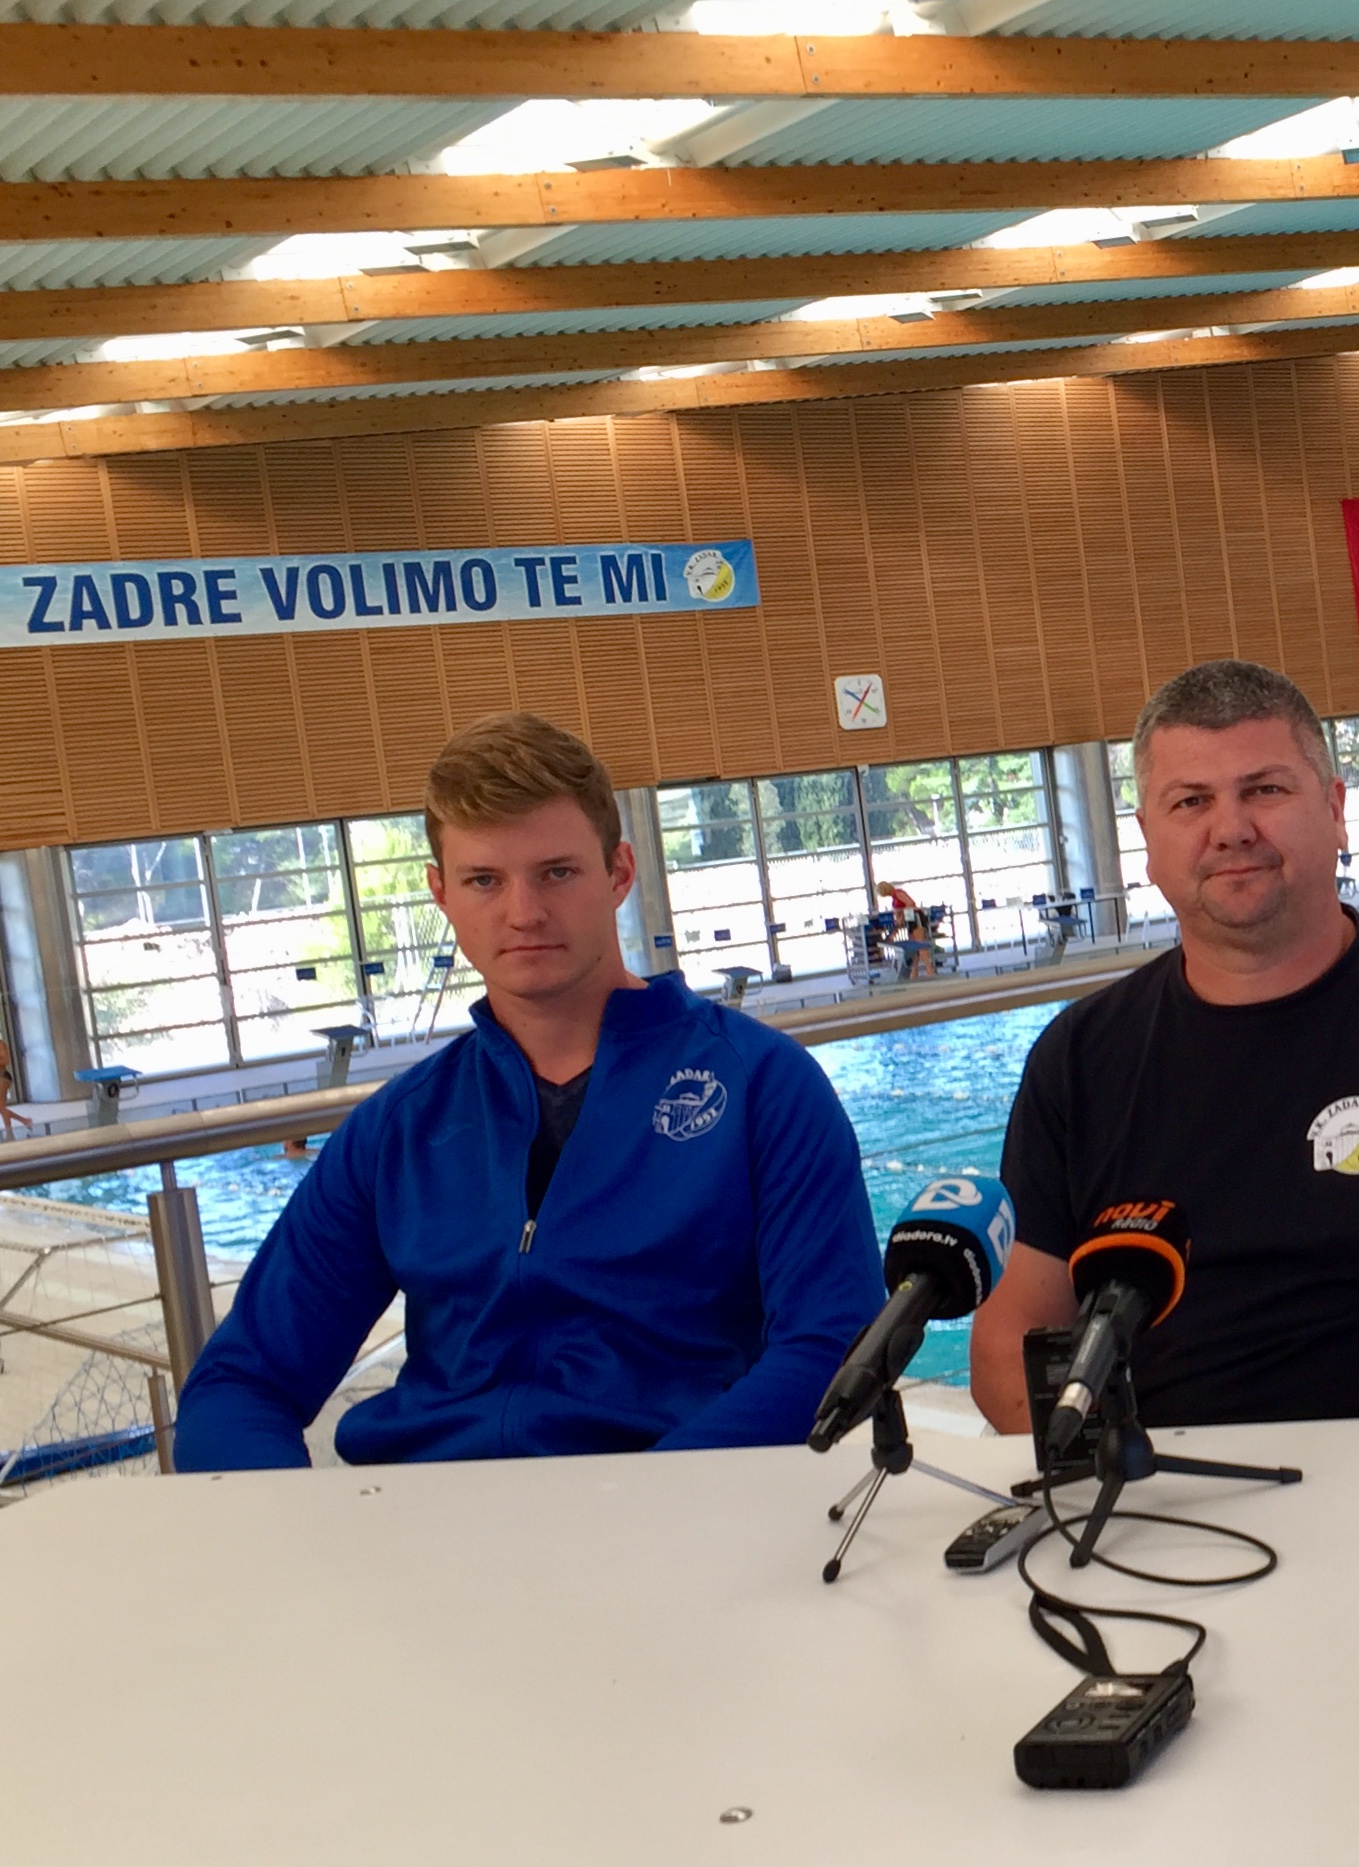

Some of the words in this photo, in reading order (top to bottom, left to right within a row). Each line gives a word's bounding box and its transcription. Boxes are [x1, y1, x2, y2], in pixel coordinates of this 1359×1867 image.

[22, 570, 243, 633] ZADRE
[259, 557, 498, 621] VOLIMO
[514, 555, 583, 608] TE
[600, 552, 668, 605] MI
